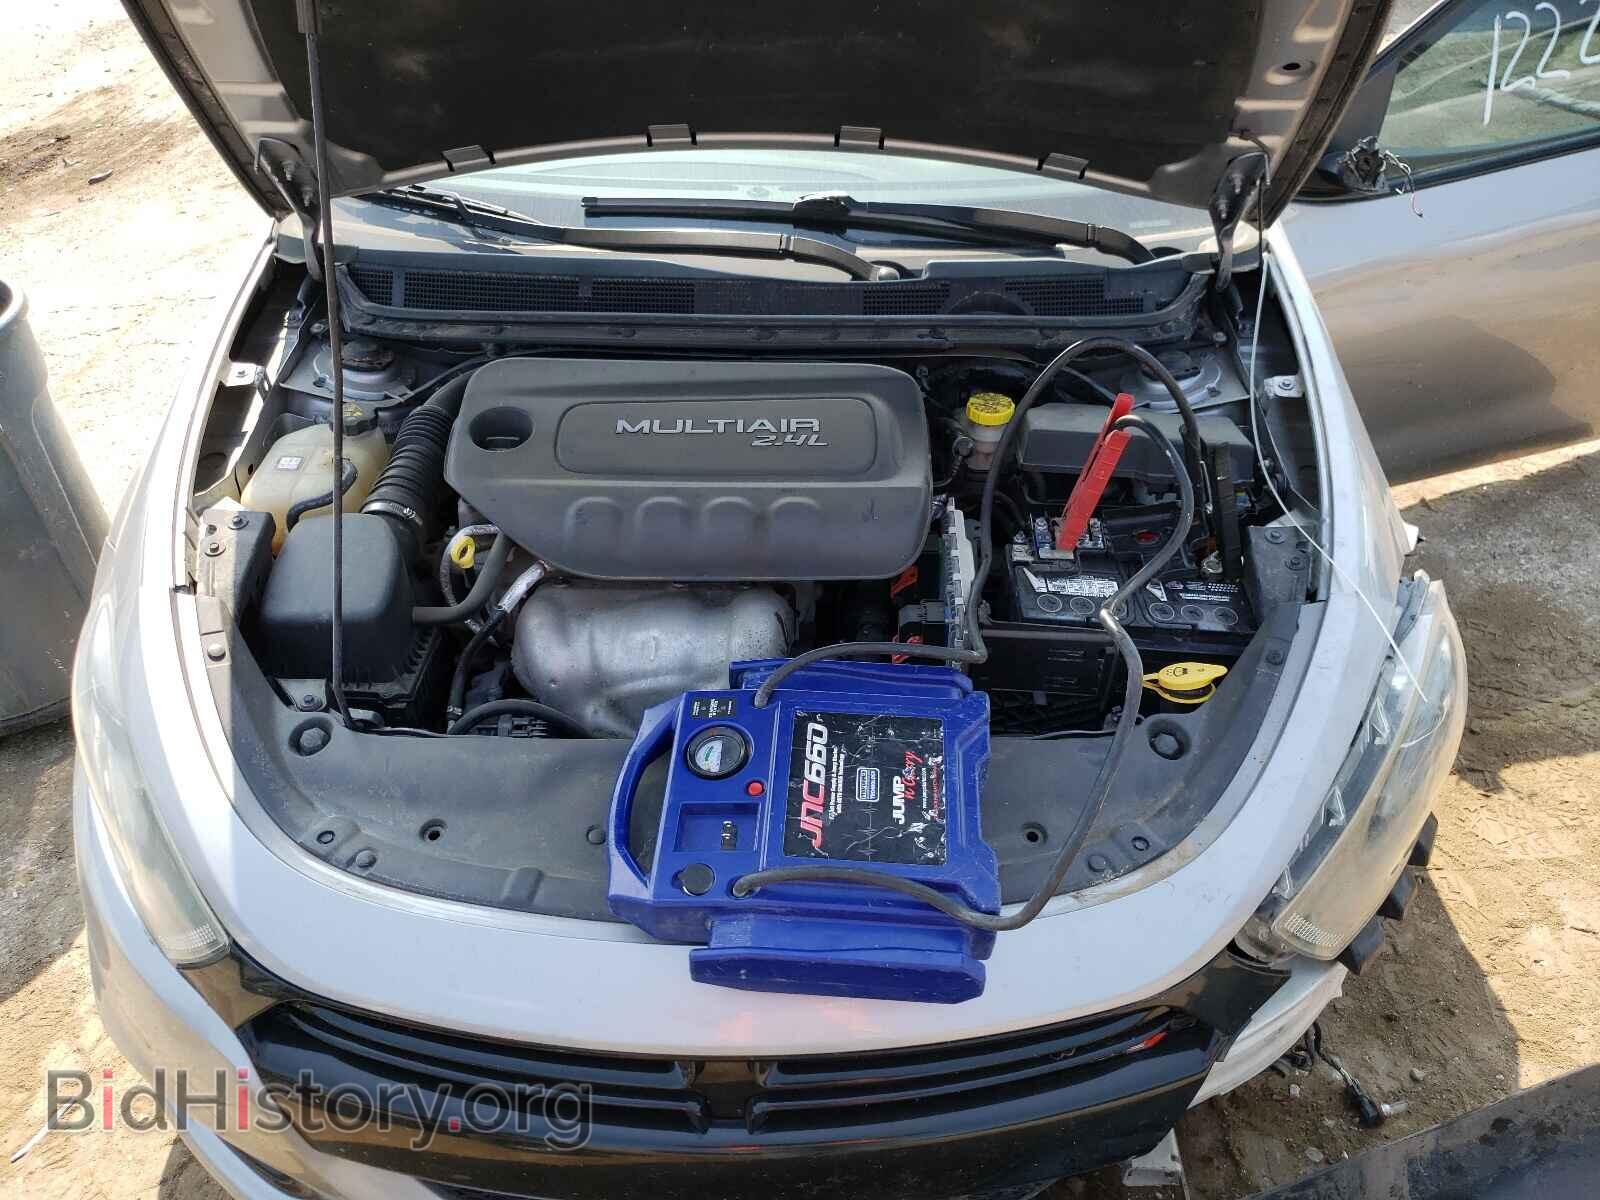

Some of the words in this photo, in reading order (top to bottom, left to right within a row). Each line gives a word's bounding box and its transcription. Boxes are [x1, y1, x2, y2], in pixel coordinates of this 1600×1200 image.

[615, 418, 820, 434] MULTIAIR
[751, 434, 828, 446] 2.4L
[801, 721, 828, 849] JNC660
[892, 775, 905, 825] JUMP
